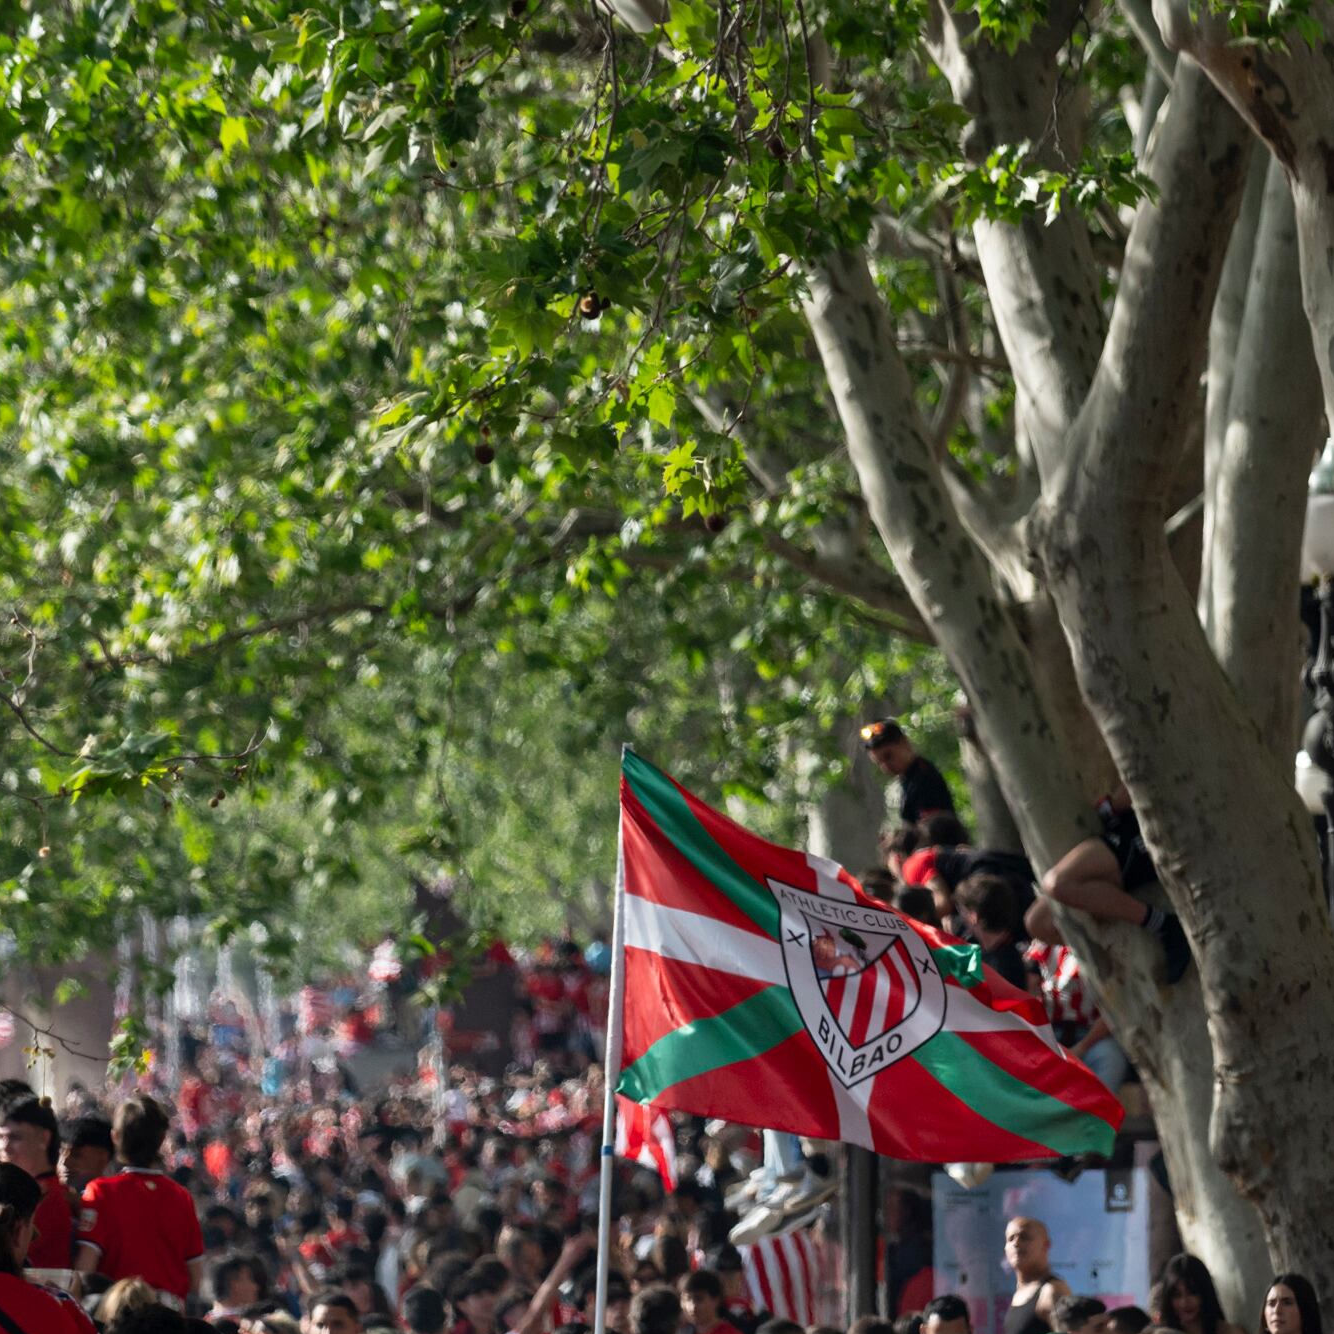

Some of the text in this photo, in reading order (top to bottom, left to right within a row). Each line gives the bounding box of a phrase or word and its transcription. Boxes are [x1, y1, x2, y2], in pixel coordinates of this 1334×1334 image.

[780, 888, 909, 932] ATHLETIC CLUB
[817, 1014, 903, 1079] BILBAO
